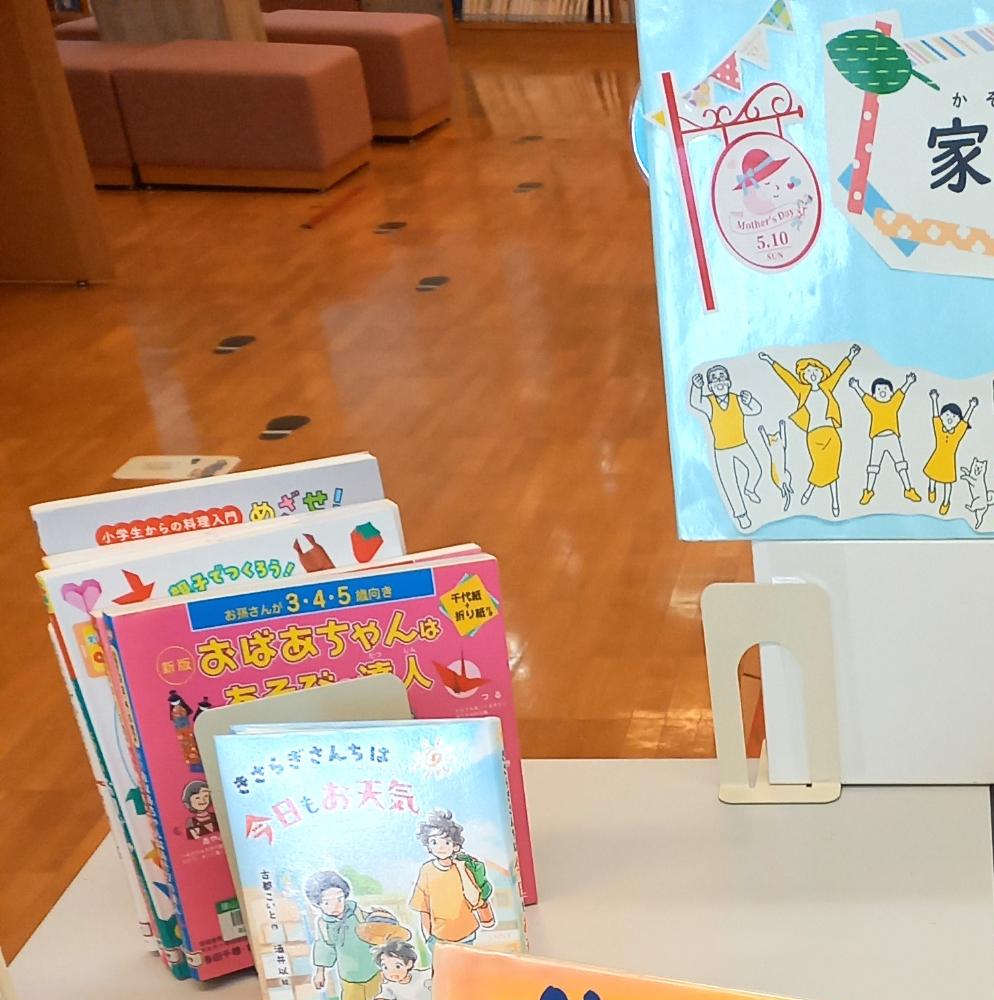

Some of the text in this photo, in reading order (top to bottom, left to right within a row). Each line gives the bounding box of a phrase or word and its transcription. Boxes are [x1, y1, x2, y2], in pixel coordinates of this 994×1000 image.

[736, 207, 794, 231] Mother's Day
[756, 231, 789, 250] 5.10
[102, 511, 239, 545] 小学生からの料理入門
[451, 590, 482, 604] 千代紙
[197, 609, 443, 677] おばあちゃんは
[233, 743, 390, 795] きさらぎさんちは
[244, 779, 420, 846] 今日もお天気
